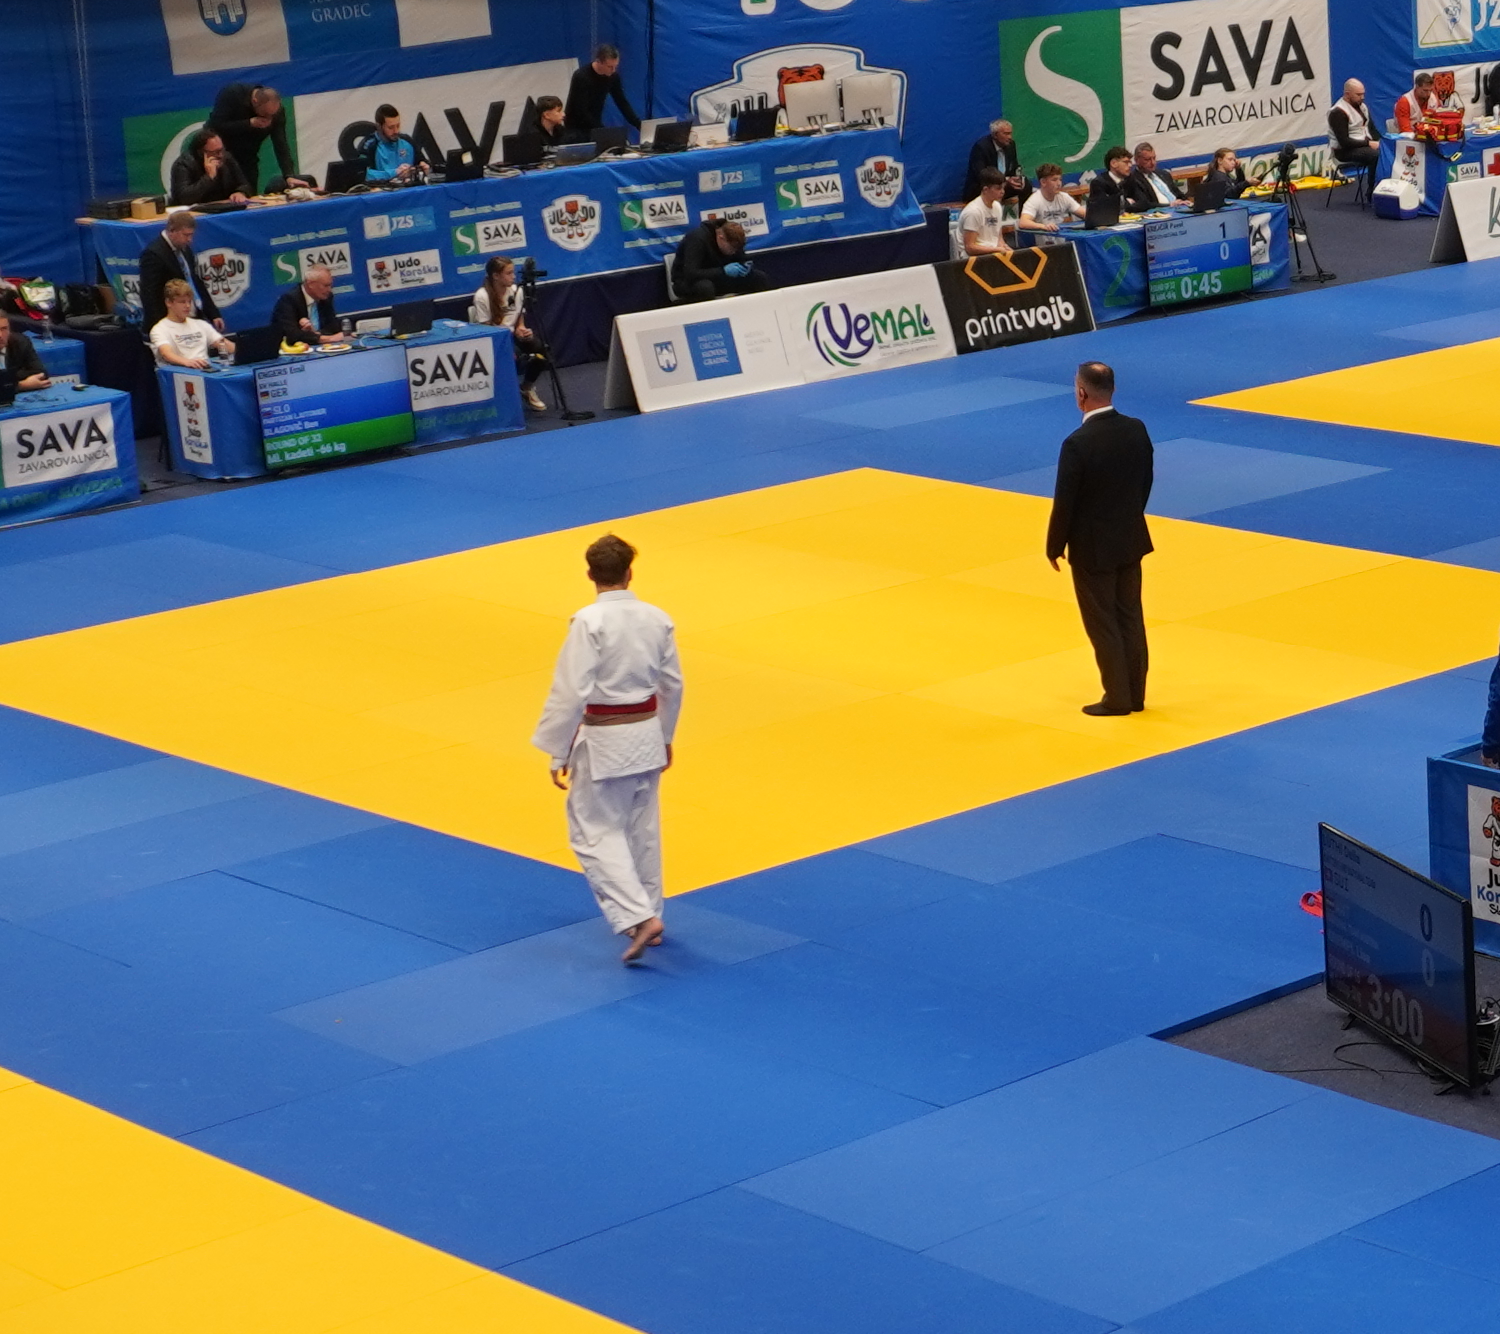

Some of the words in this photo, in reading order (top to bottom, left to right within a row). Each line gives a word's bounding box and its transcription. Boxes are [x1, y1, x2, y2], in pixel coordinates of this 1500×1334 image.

[312, 3, 371, 22] GRADEC
[1150, 15, 1315, 101] SAVA
[1155, 92, 1316, 134] ZAVAROVALNICA
[803, 179, 841, 196] SAVA
[649, 201, 685, 218] SAVA
[482, 220, 522, 240] SAVA
[306, 244, 350, 268] SAVA
[1220, 241, 1230, 260] 0
[1103, 235, 1138, 310] 2
[1180, 272, 1222, 299] 0:45
[965, 296, 1075, 346] printvajb
[410, 350, 489, 387] SAVA
[413, 381, 489, 401] ZAVAROVALNICA
[16, 417, 108, 459] SAVA
[18, 449, 110, 474] ZAVAROVALNICA
[1366, 973, 1424, 1046] 3:00
